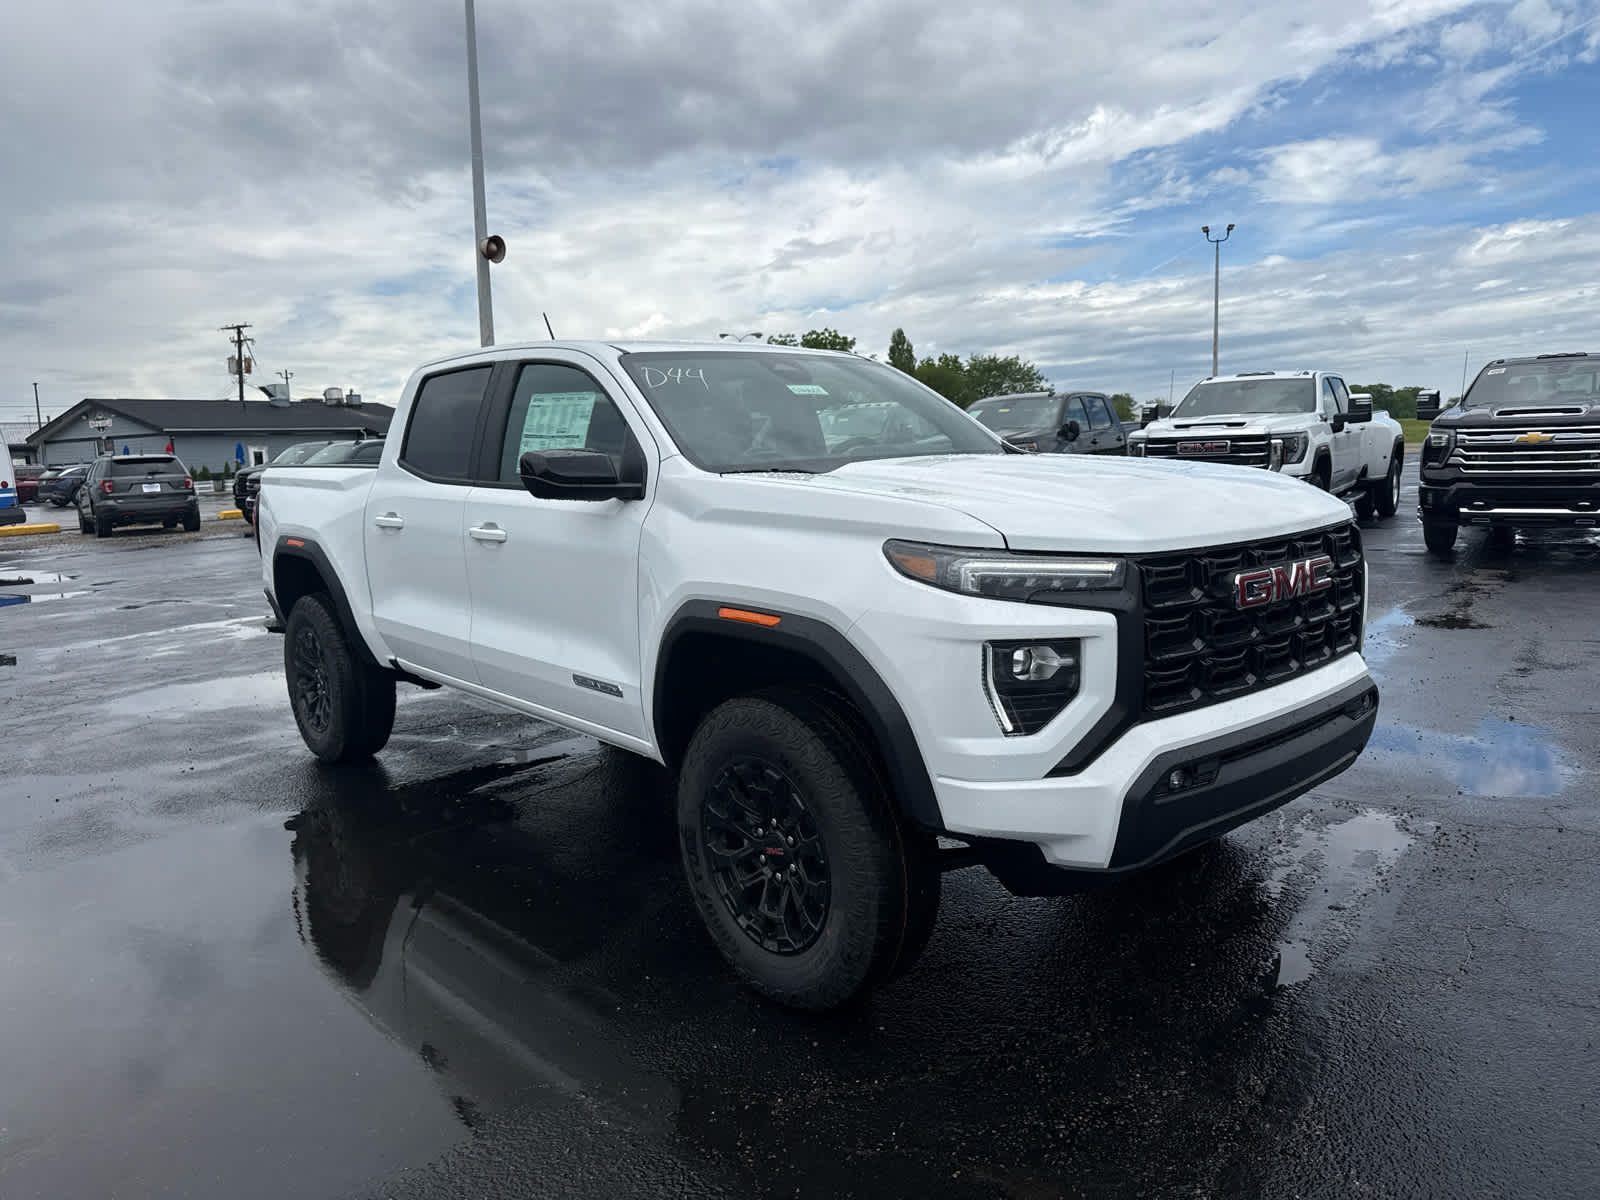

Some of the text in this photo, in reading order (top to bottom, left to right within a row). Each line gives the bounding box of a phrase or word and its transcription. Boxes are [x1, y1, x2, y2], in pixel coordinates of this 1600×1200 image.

[641, 367, 709, 391] D44
[1180, 442, 1226, 453] GMC
[1235, 555, 1333, 610] GMC
